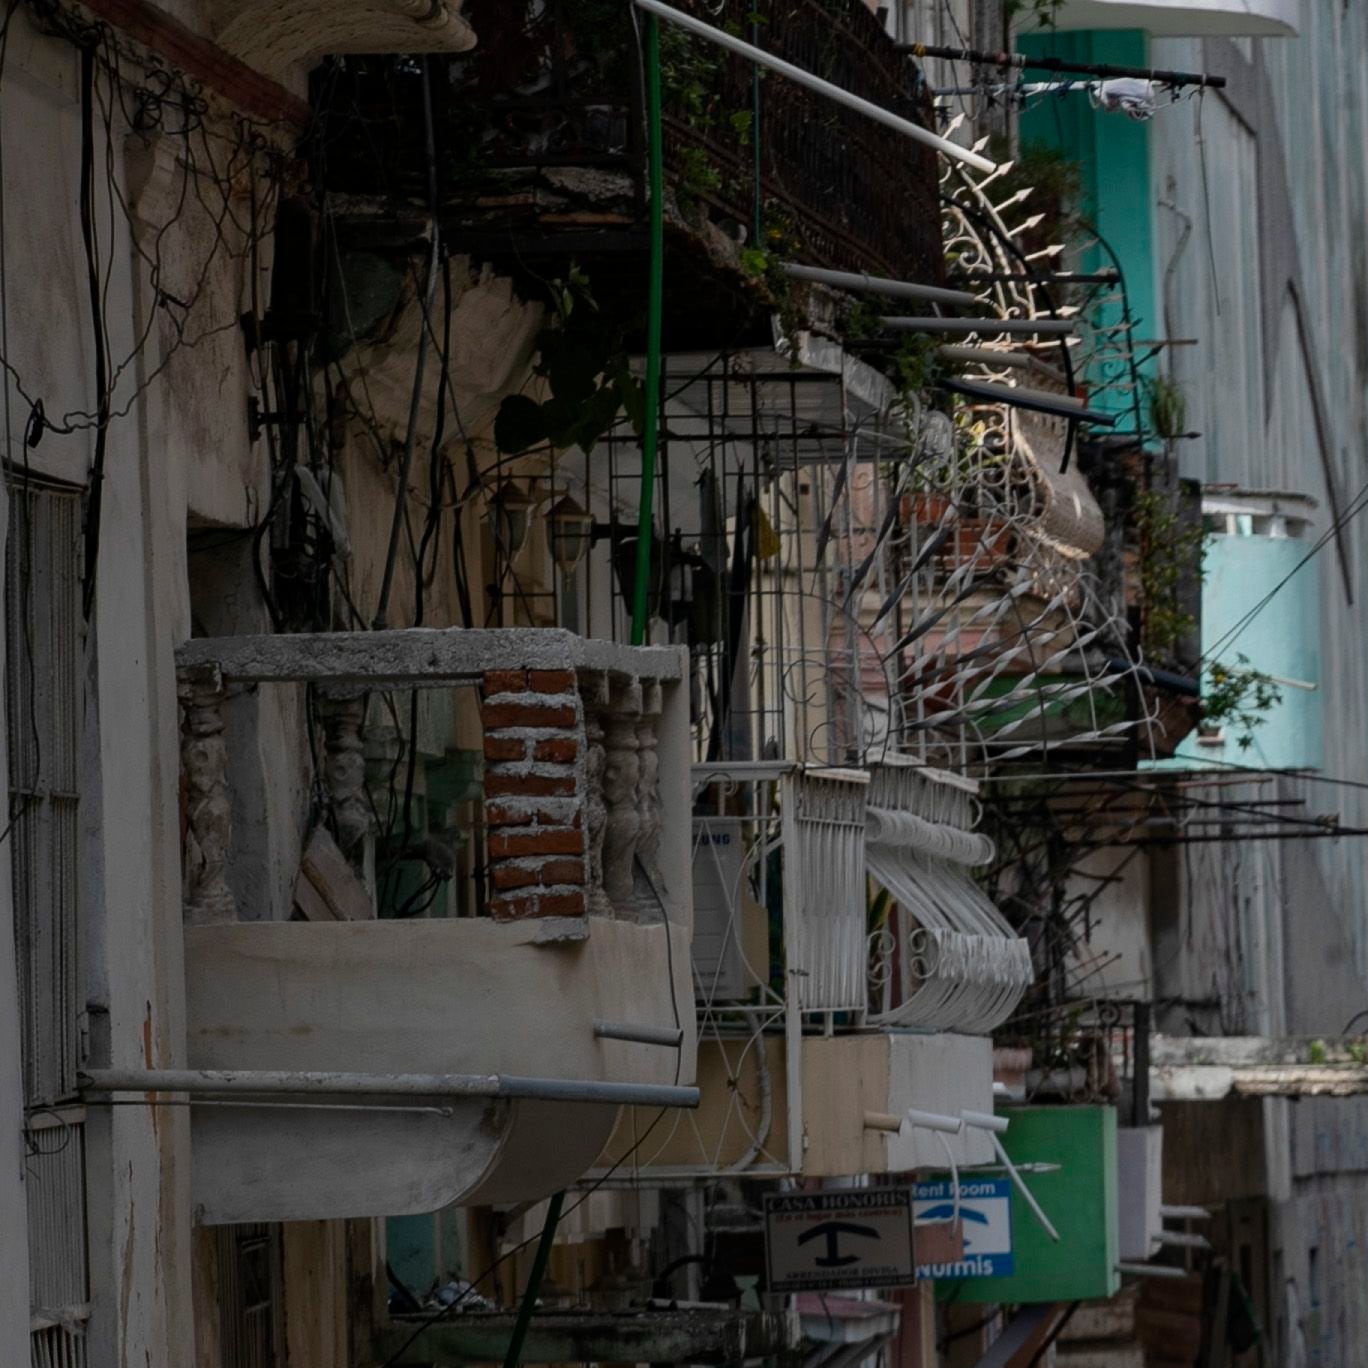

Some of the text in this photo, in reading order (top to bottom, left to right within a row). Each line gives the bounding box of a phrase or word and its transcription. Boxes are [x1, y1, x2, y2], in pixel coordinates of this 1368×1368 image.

[767, 1191, 908, 1211] CASA HONORIS
[914, 1255, 994, 1278] Nurmis
